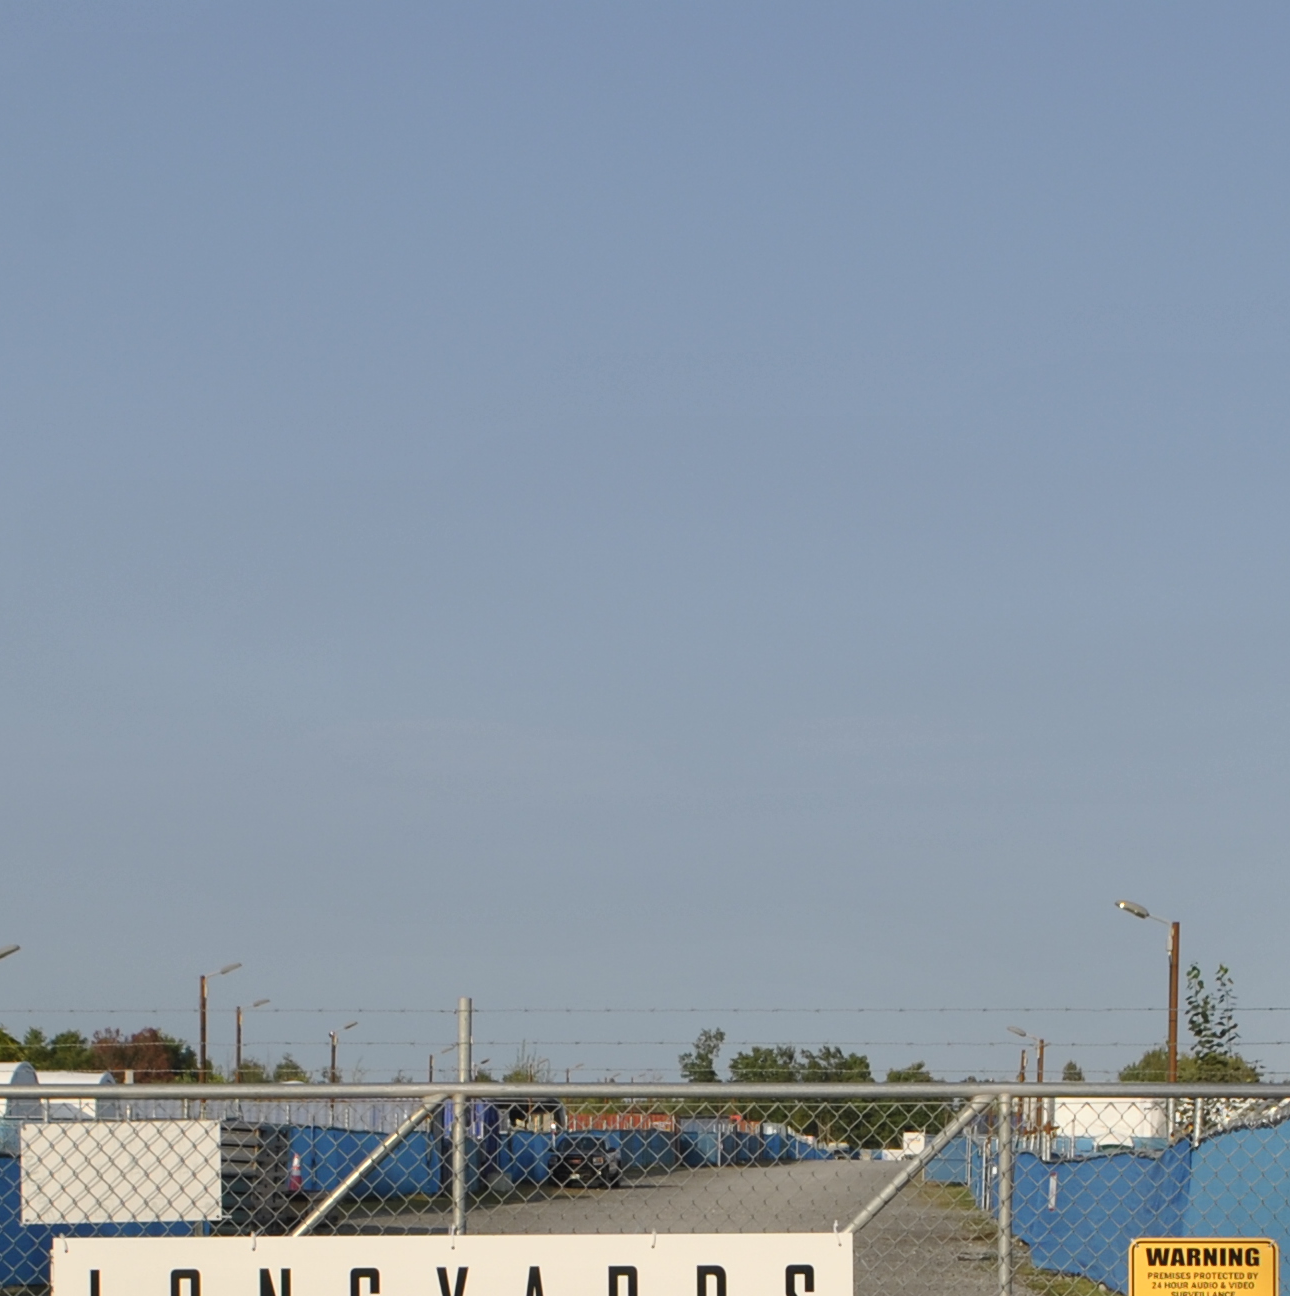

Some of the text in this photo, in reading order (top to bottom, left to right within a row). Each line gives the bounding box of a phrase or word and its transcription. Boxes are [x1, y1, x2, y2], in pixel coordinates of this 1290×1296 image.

[1146, 1247, 1260, 1267] WARNING
[1147, 1272, 1258, 1280] PREMISES PROTECTED BY
[1151, 1282, 1162, 1290] 24
[1191, 1282, 1218, 1290] AUDIO
[1228, 1282, 1254, 1290] VIDEO
